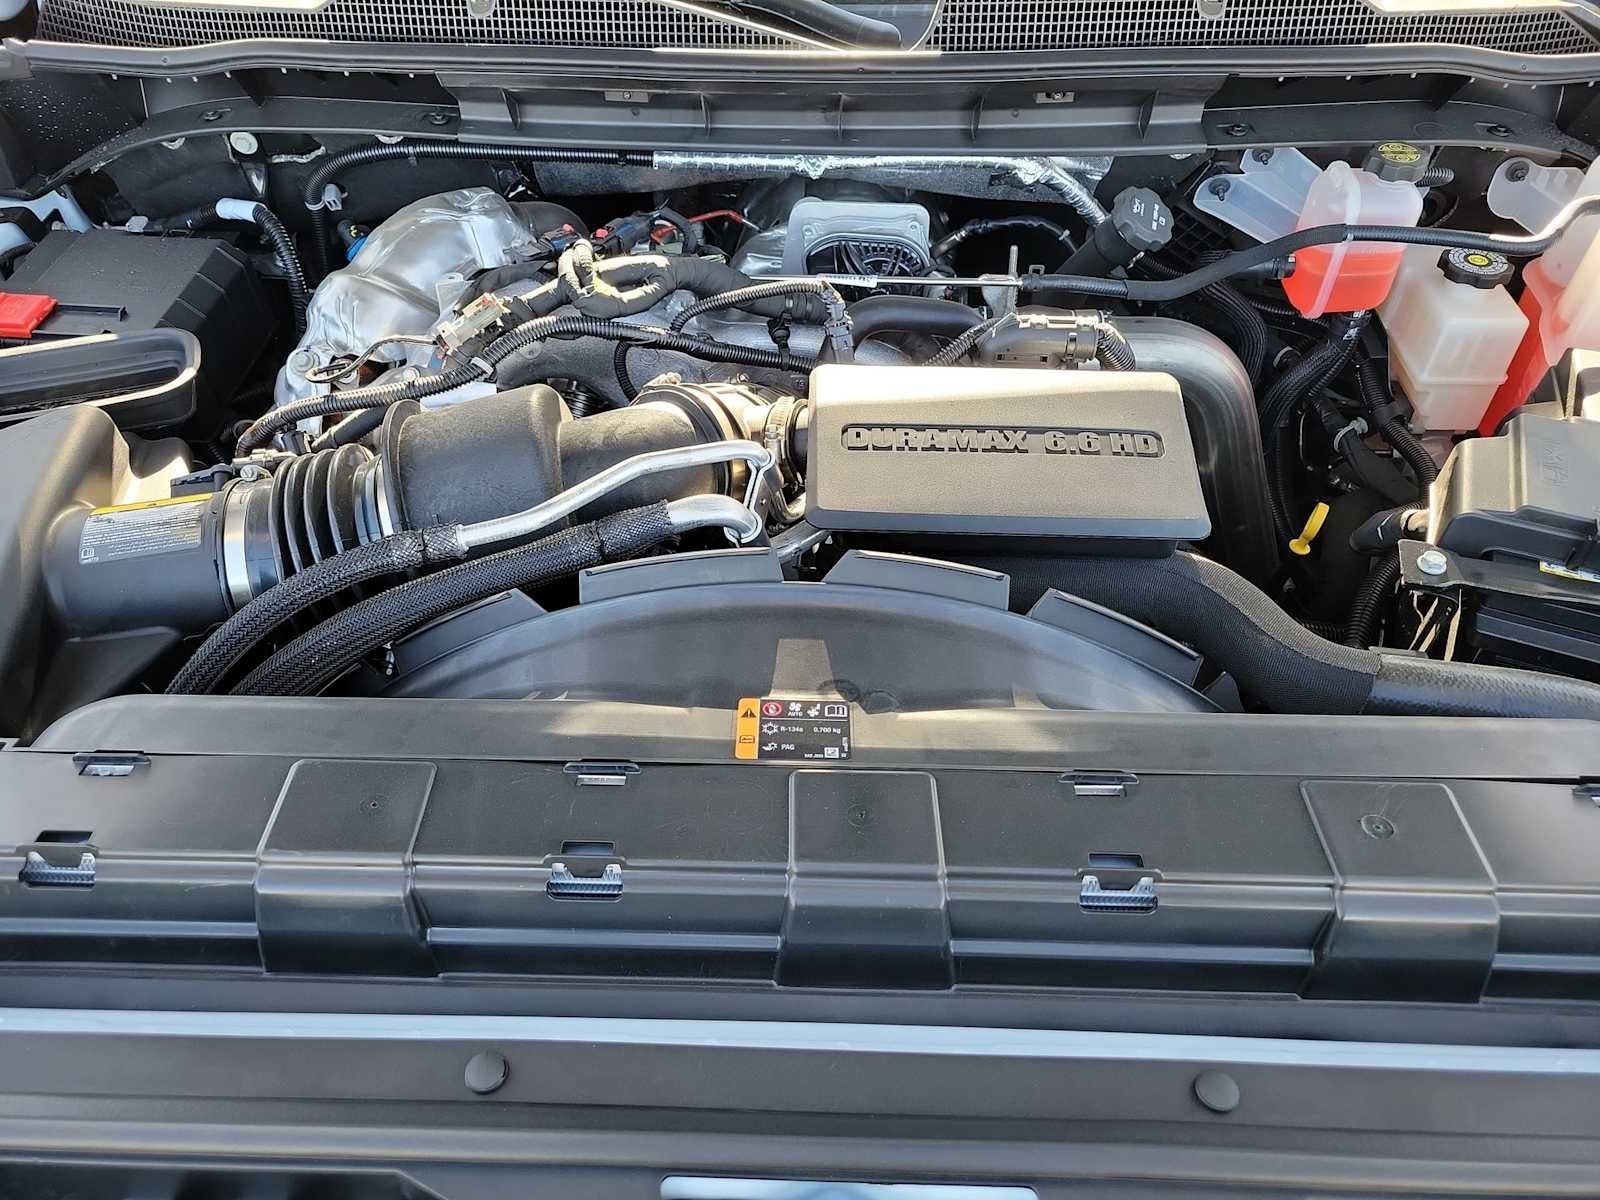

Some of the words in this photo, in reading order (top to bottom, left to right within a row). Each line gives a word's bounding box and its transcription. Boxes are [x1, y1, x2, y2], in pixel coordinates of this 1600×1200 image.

[846, 426, 1029, 453] DURAMAX
[1044, 430, 1100, 456] 6.6
[1109, 432, 1160, 457] HD
[780, 743, 796, 751] PAG
